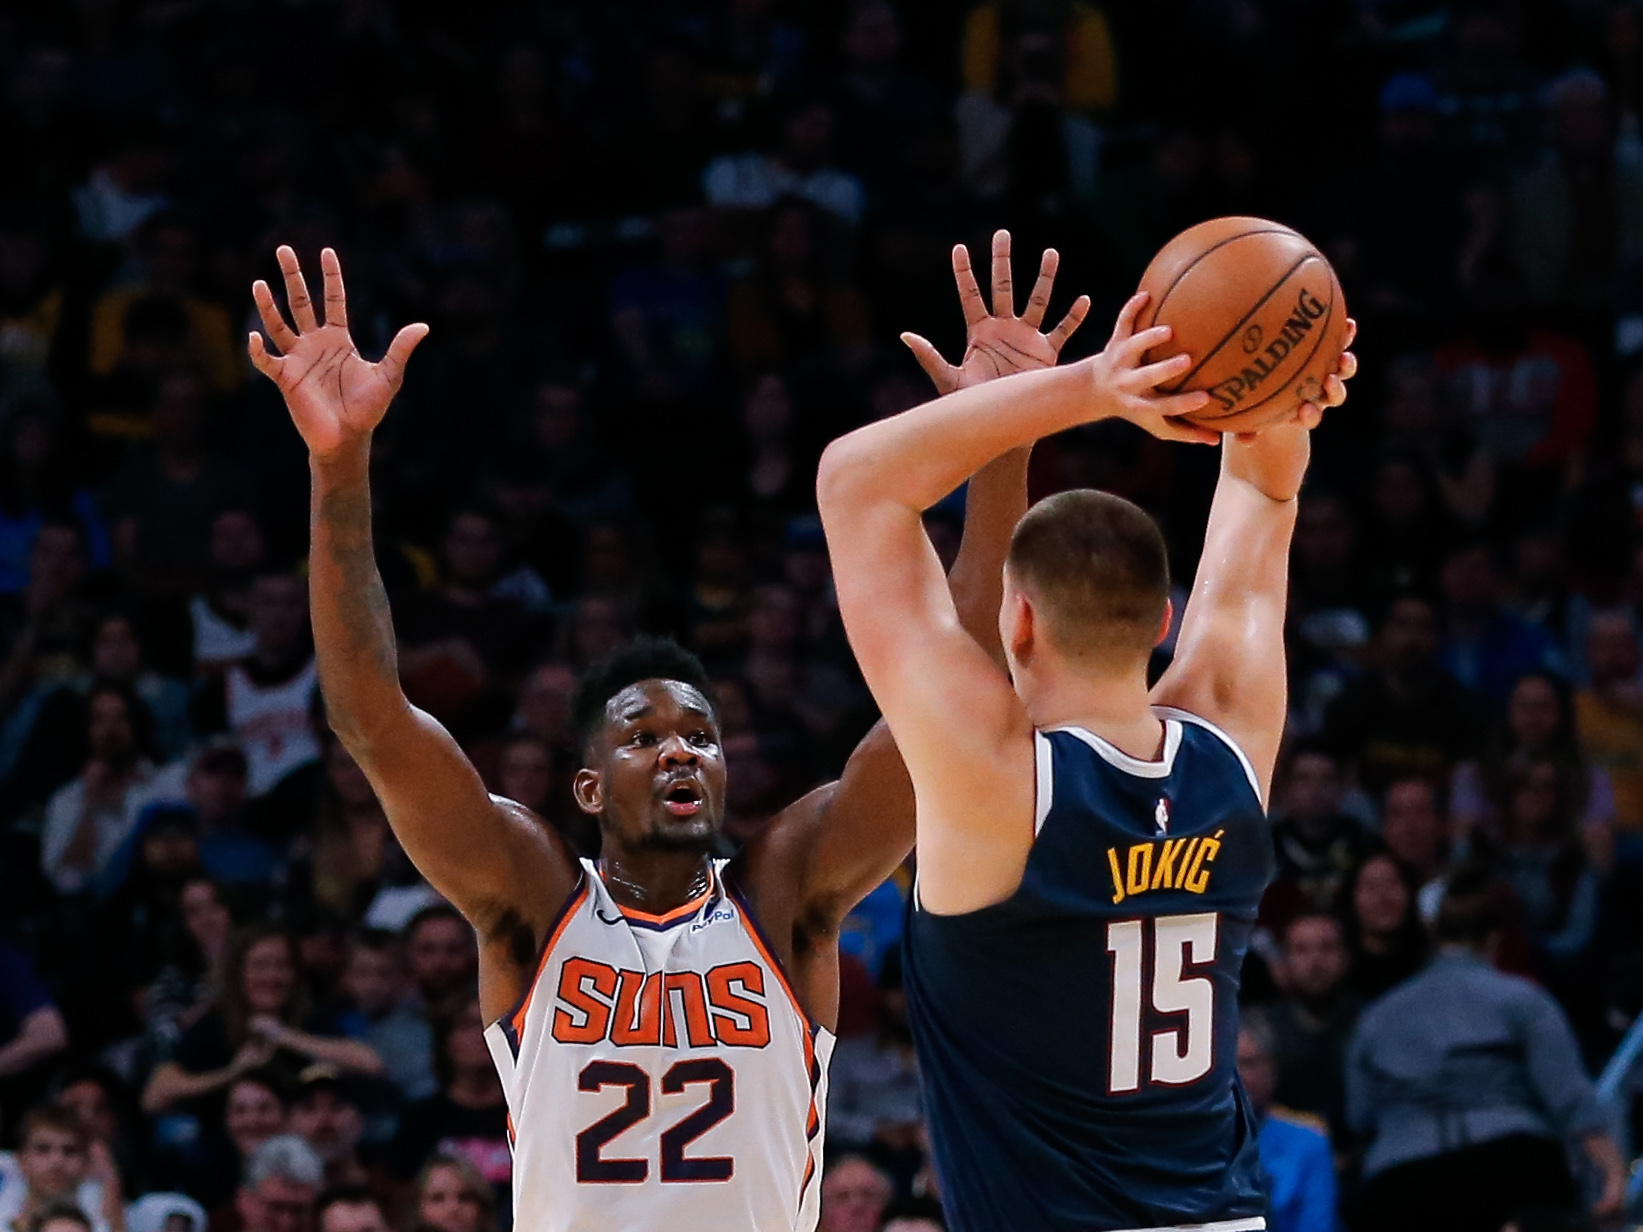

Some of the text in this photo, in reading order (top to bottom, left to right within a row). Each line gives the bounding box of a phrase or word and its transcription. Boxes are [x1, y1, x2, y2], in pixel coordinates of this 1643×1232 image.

[1207, 288, 1326, 411] SPALDING
[692, 909, 734, 932] PyPal
[1107, 829, 1224, 905] JOKIĆ
[551, 955, 772, 1049] SUNS
[1107, 911, 1218, 1093] 15
[575, 1056, 736, 1184] 22
